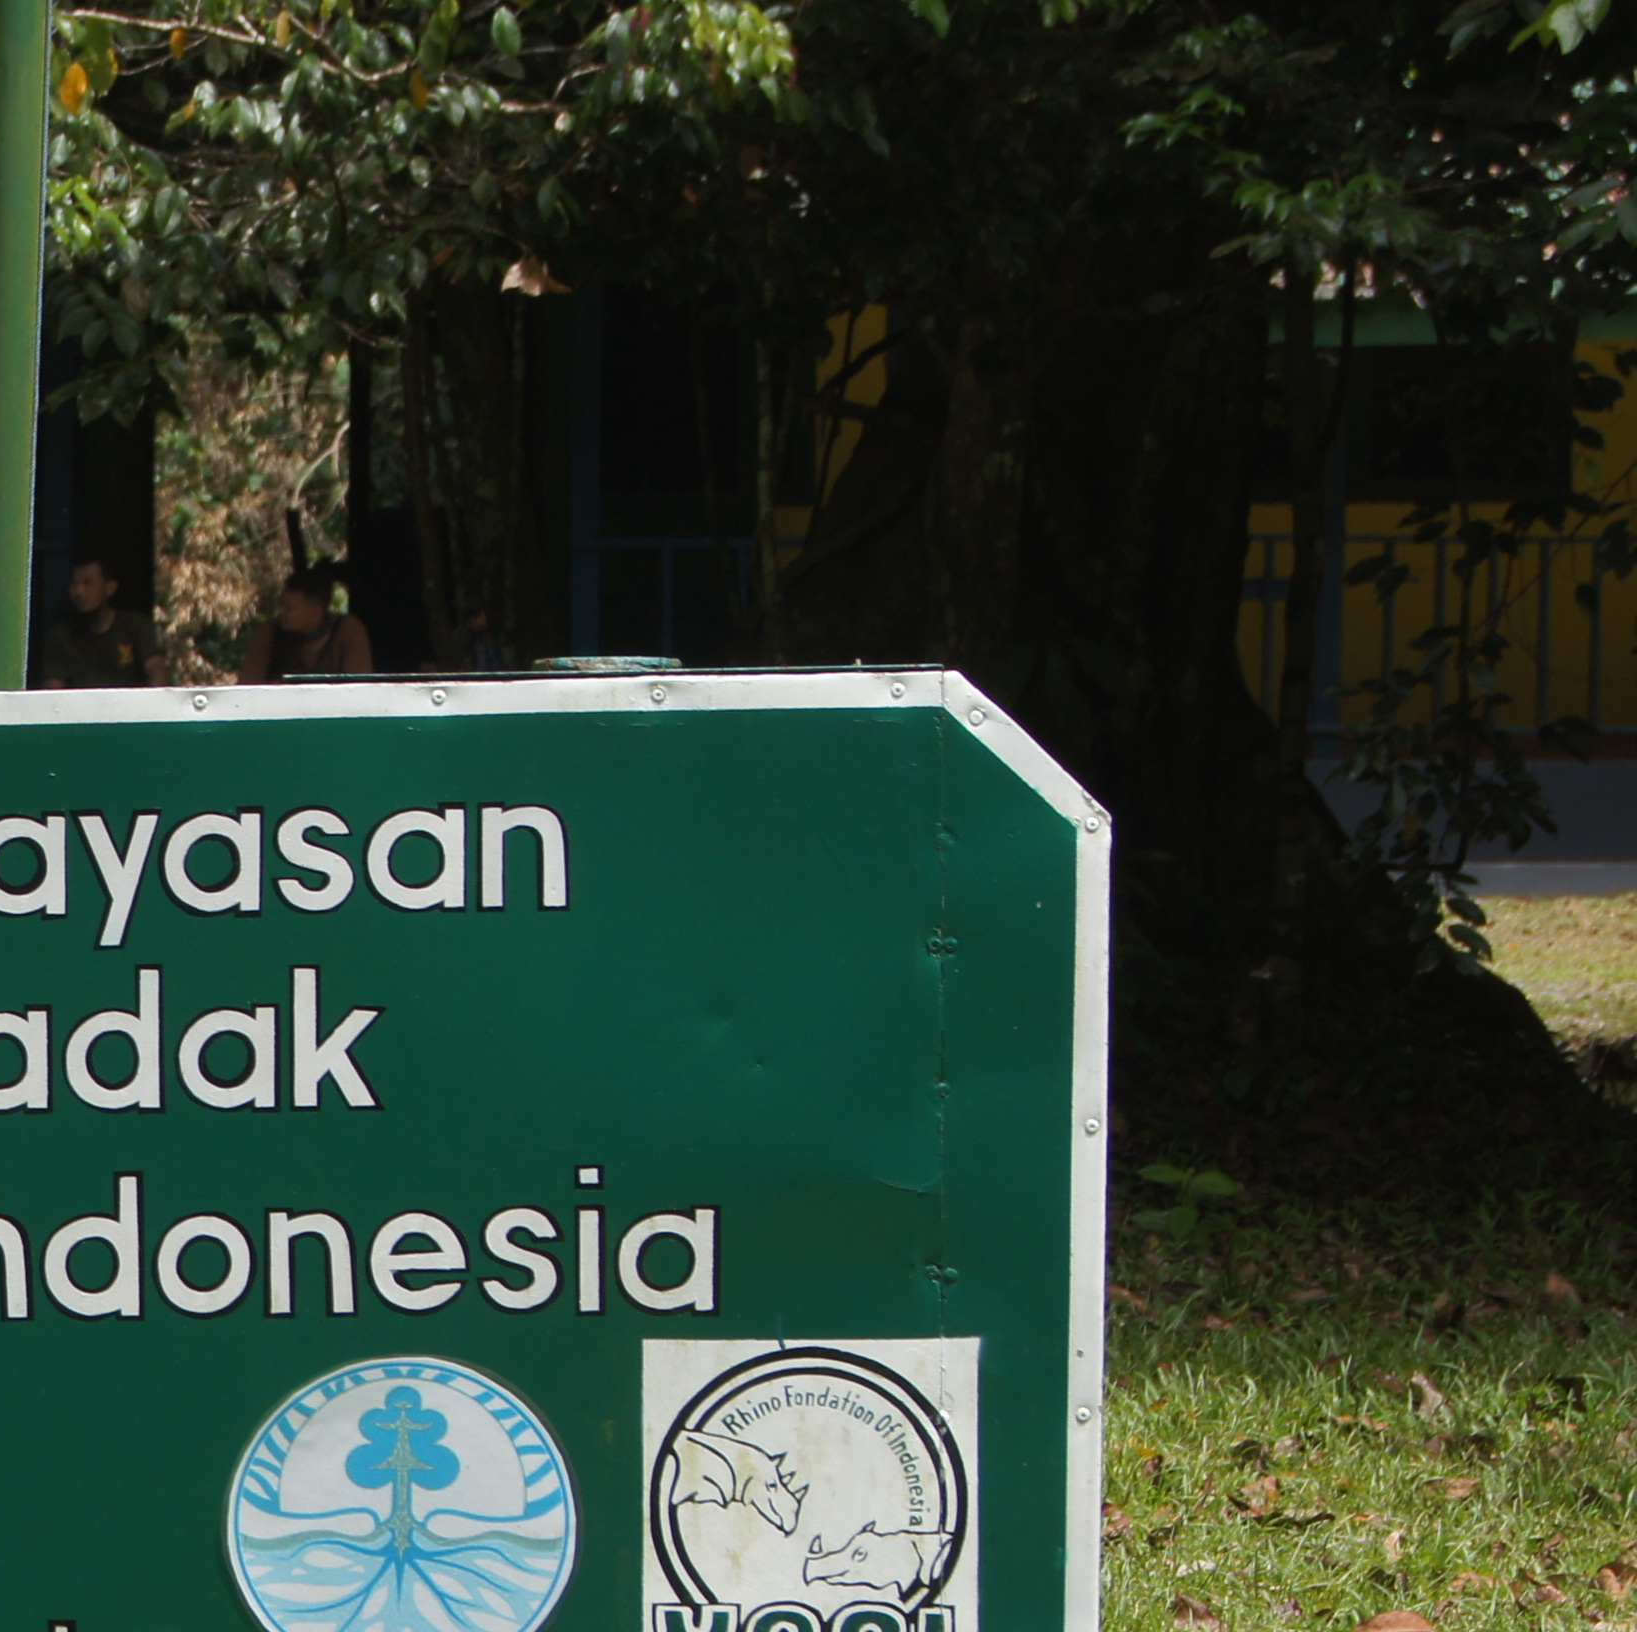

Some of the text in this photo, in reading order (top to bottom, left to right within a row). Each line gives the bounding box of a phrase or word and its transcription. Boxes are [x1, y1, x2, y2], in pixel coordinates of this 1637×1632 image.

[721, 1396, 783, 1437] Rhino
[783, 1384, 875, 1428] Fondation
[887, 1430, 932, 1528] Indonesia
